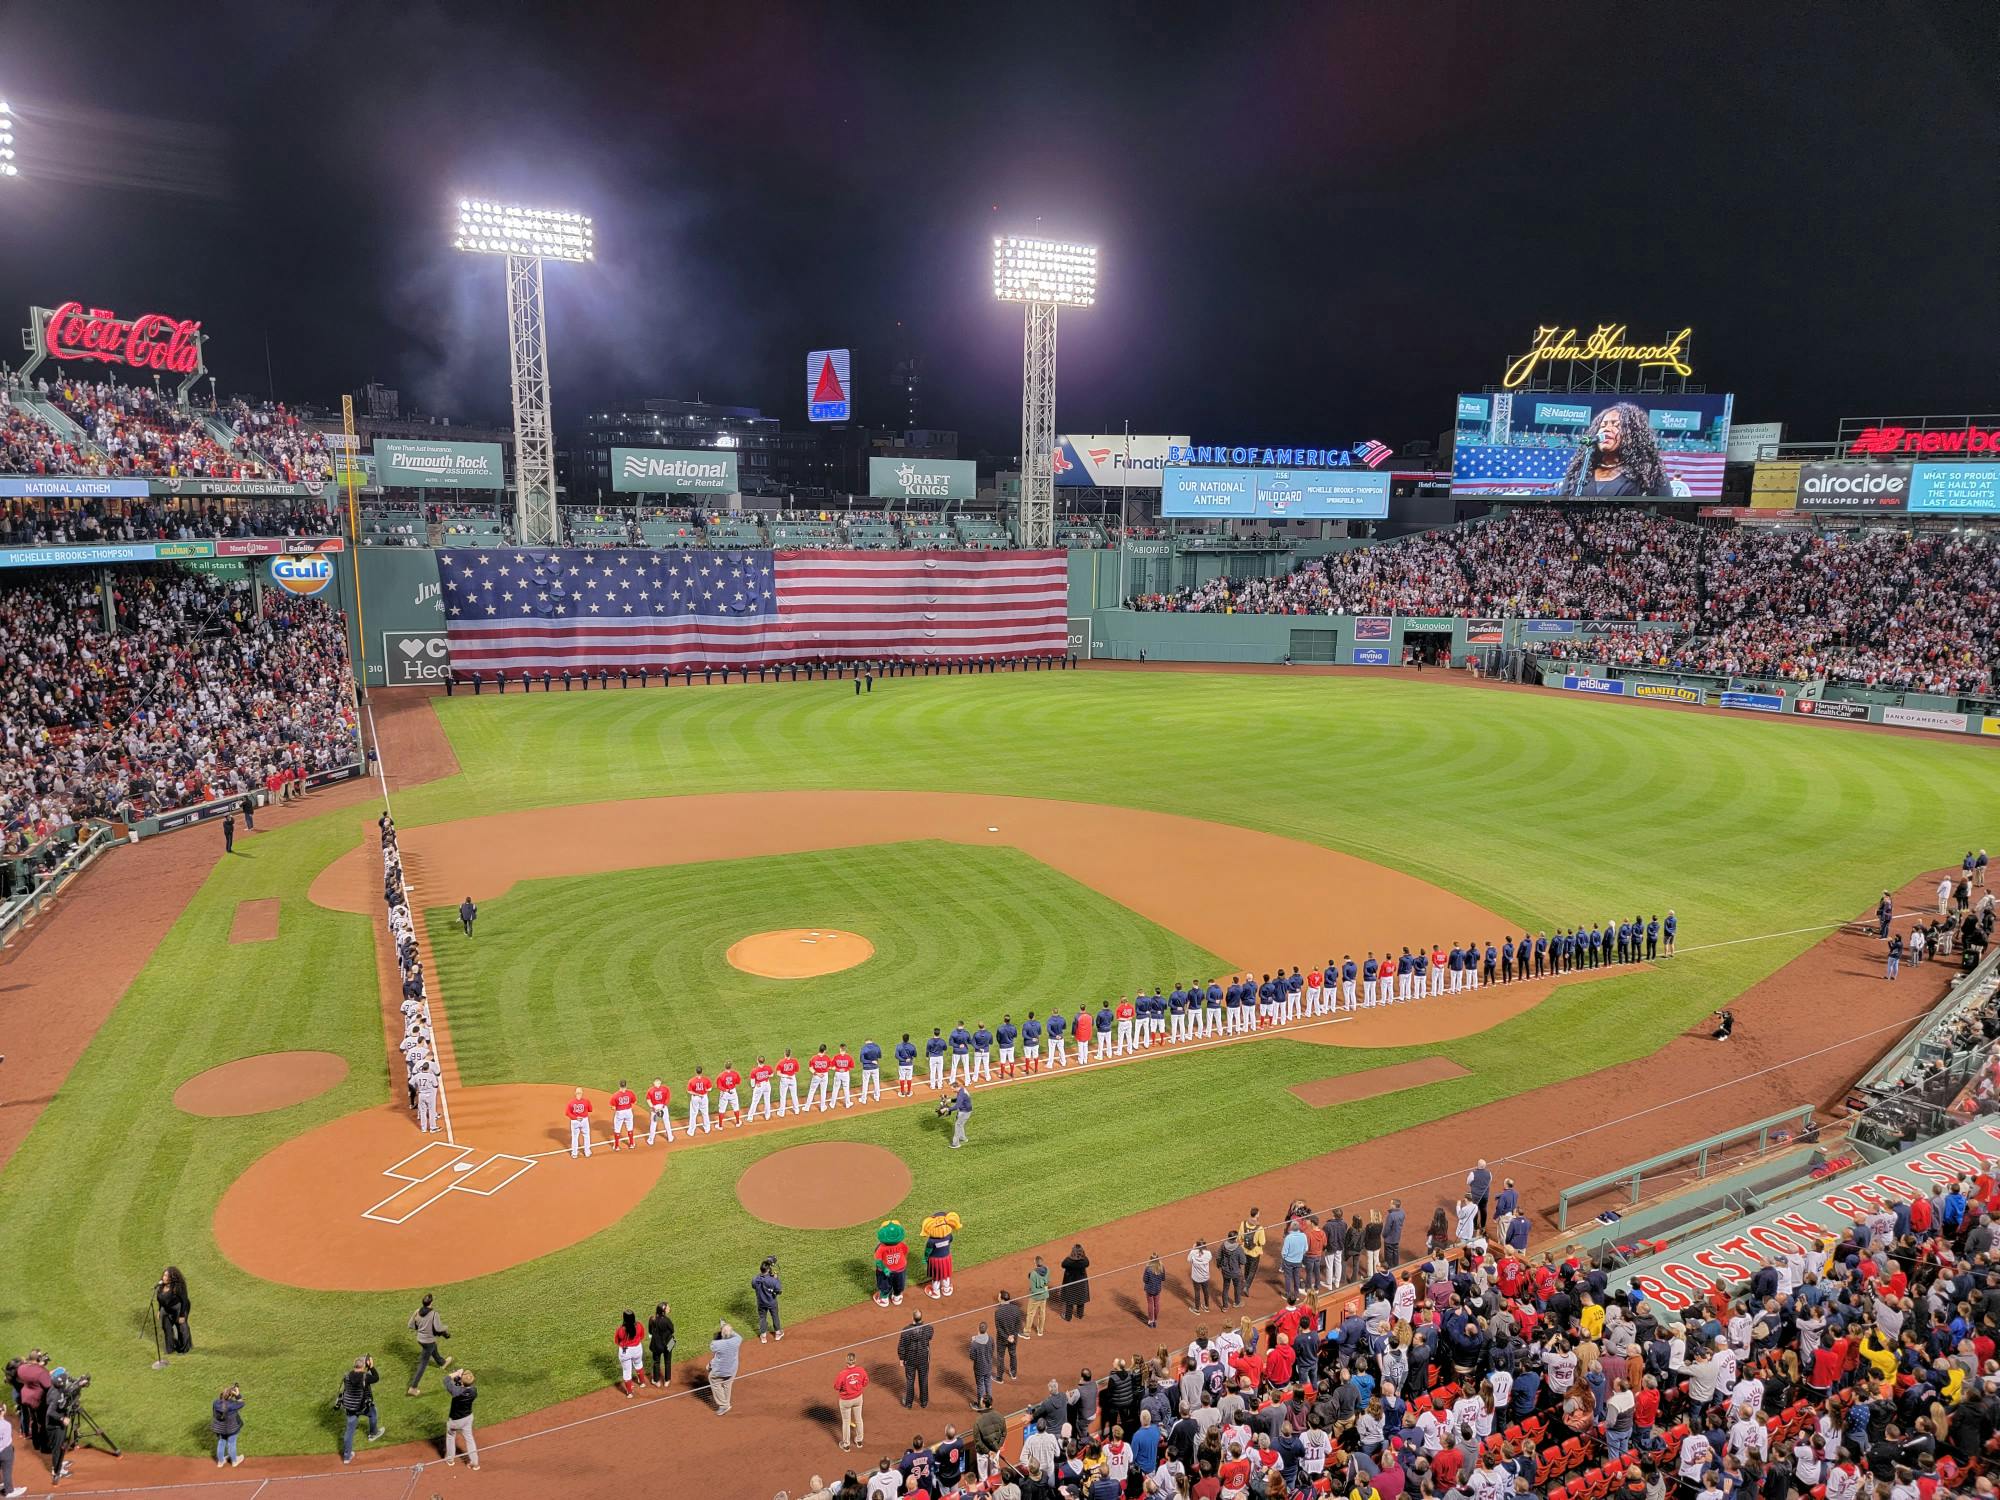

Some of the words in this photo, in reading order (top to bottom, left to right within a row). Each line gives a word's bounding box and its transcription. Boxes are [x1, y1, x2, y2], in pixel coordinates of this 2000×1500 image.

[47, 302, 202, 373] Coca-Cola
[1503, 325, 1579, 387] John
[1577, 323, 1692, 376] Hancock
[812, 401, 846, 418] CITGO
[1551, 409, 1588, 418] National
[392, 453, 453, 467] Plymouth
[456, 456, 488, 469] Rock
[1168, 446, 1226, 463] BANK
[1232, 447, 1258, 464] OF
[1262, 448, 1350, 466] AMERICA
[445, 467, 489, 475] assurance
[1923, 472, 1946, 480] WHAT
[899, 473, 950, 486] DRAFT
[1804, 473, 1904, 493] airocide
[25, 483, 73, 493] NATIONAL
[75, 483, 111, 493] ANTHEM
[214, 484, 242, 493] BLACK
[243, 485, 265, 493] LIVES
[266, 485, 295, 493] MATTER
[905, 484, 949, 495] KINGS
[1179, 482, 1197, 491] OUR
[1200, 482, 1245, 492] NATIONAL
[1933, 481, 1946, 489] WE
[1948, 481, 1976, 489] HAIL'D
[1979, 481, 1992, 489] AT
[1258, 490, 1279, 501] WILD
[1280, 490, 1302, 501] CARD
[1333, 487, 1383, 495] BROOKS-THOMPSON
[1928, 490, 1944, 498] THE
[1948, 490, 1995, 498] TWILIGHT'S
[1194, 495, 1230, 505] ANTHEM
[1923, 499, 1945, 507] LAST
[1948, 500, 1997, 508] GLEAMING,
[1134, 546, 1170, 554] ABIOMED
[10, 553, 54, 563] MICHELLE
[55, 549, 133, 561] BROOKS-THOMPSON
[199, 561, 210, 569] all
[275, 561, 328, 578] Gulf
[1360, 653, 1382, 661] IRVING
[368, 665, 383, 673] 310
[1577, 679, 1610, 691] jetBlue
[1637, 685, 1676, 697] GRANITE
[1677, 688, 1697, 700] CITY
[1814, 707, 1836, 716] Health
[1815, 702, 1841, 711] Harvard
[1841, 705, 1865, 714] Pilgrim
[411, 1052, 422, 1060] 99
[418, 1079, 428, 1087] 17
[695, 1082, 704, 1091] 11
[1635, 1212, 1840, 1312] BOSTON
[1818, 1174, 1923, 1221] RED
[1905, 1138, 2000, 1188] SOX
[950, 1449, 958, 1463] 9
[1112, 1455, 1124, 1466] 31
[911, 1464, 930, 1480] 34
